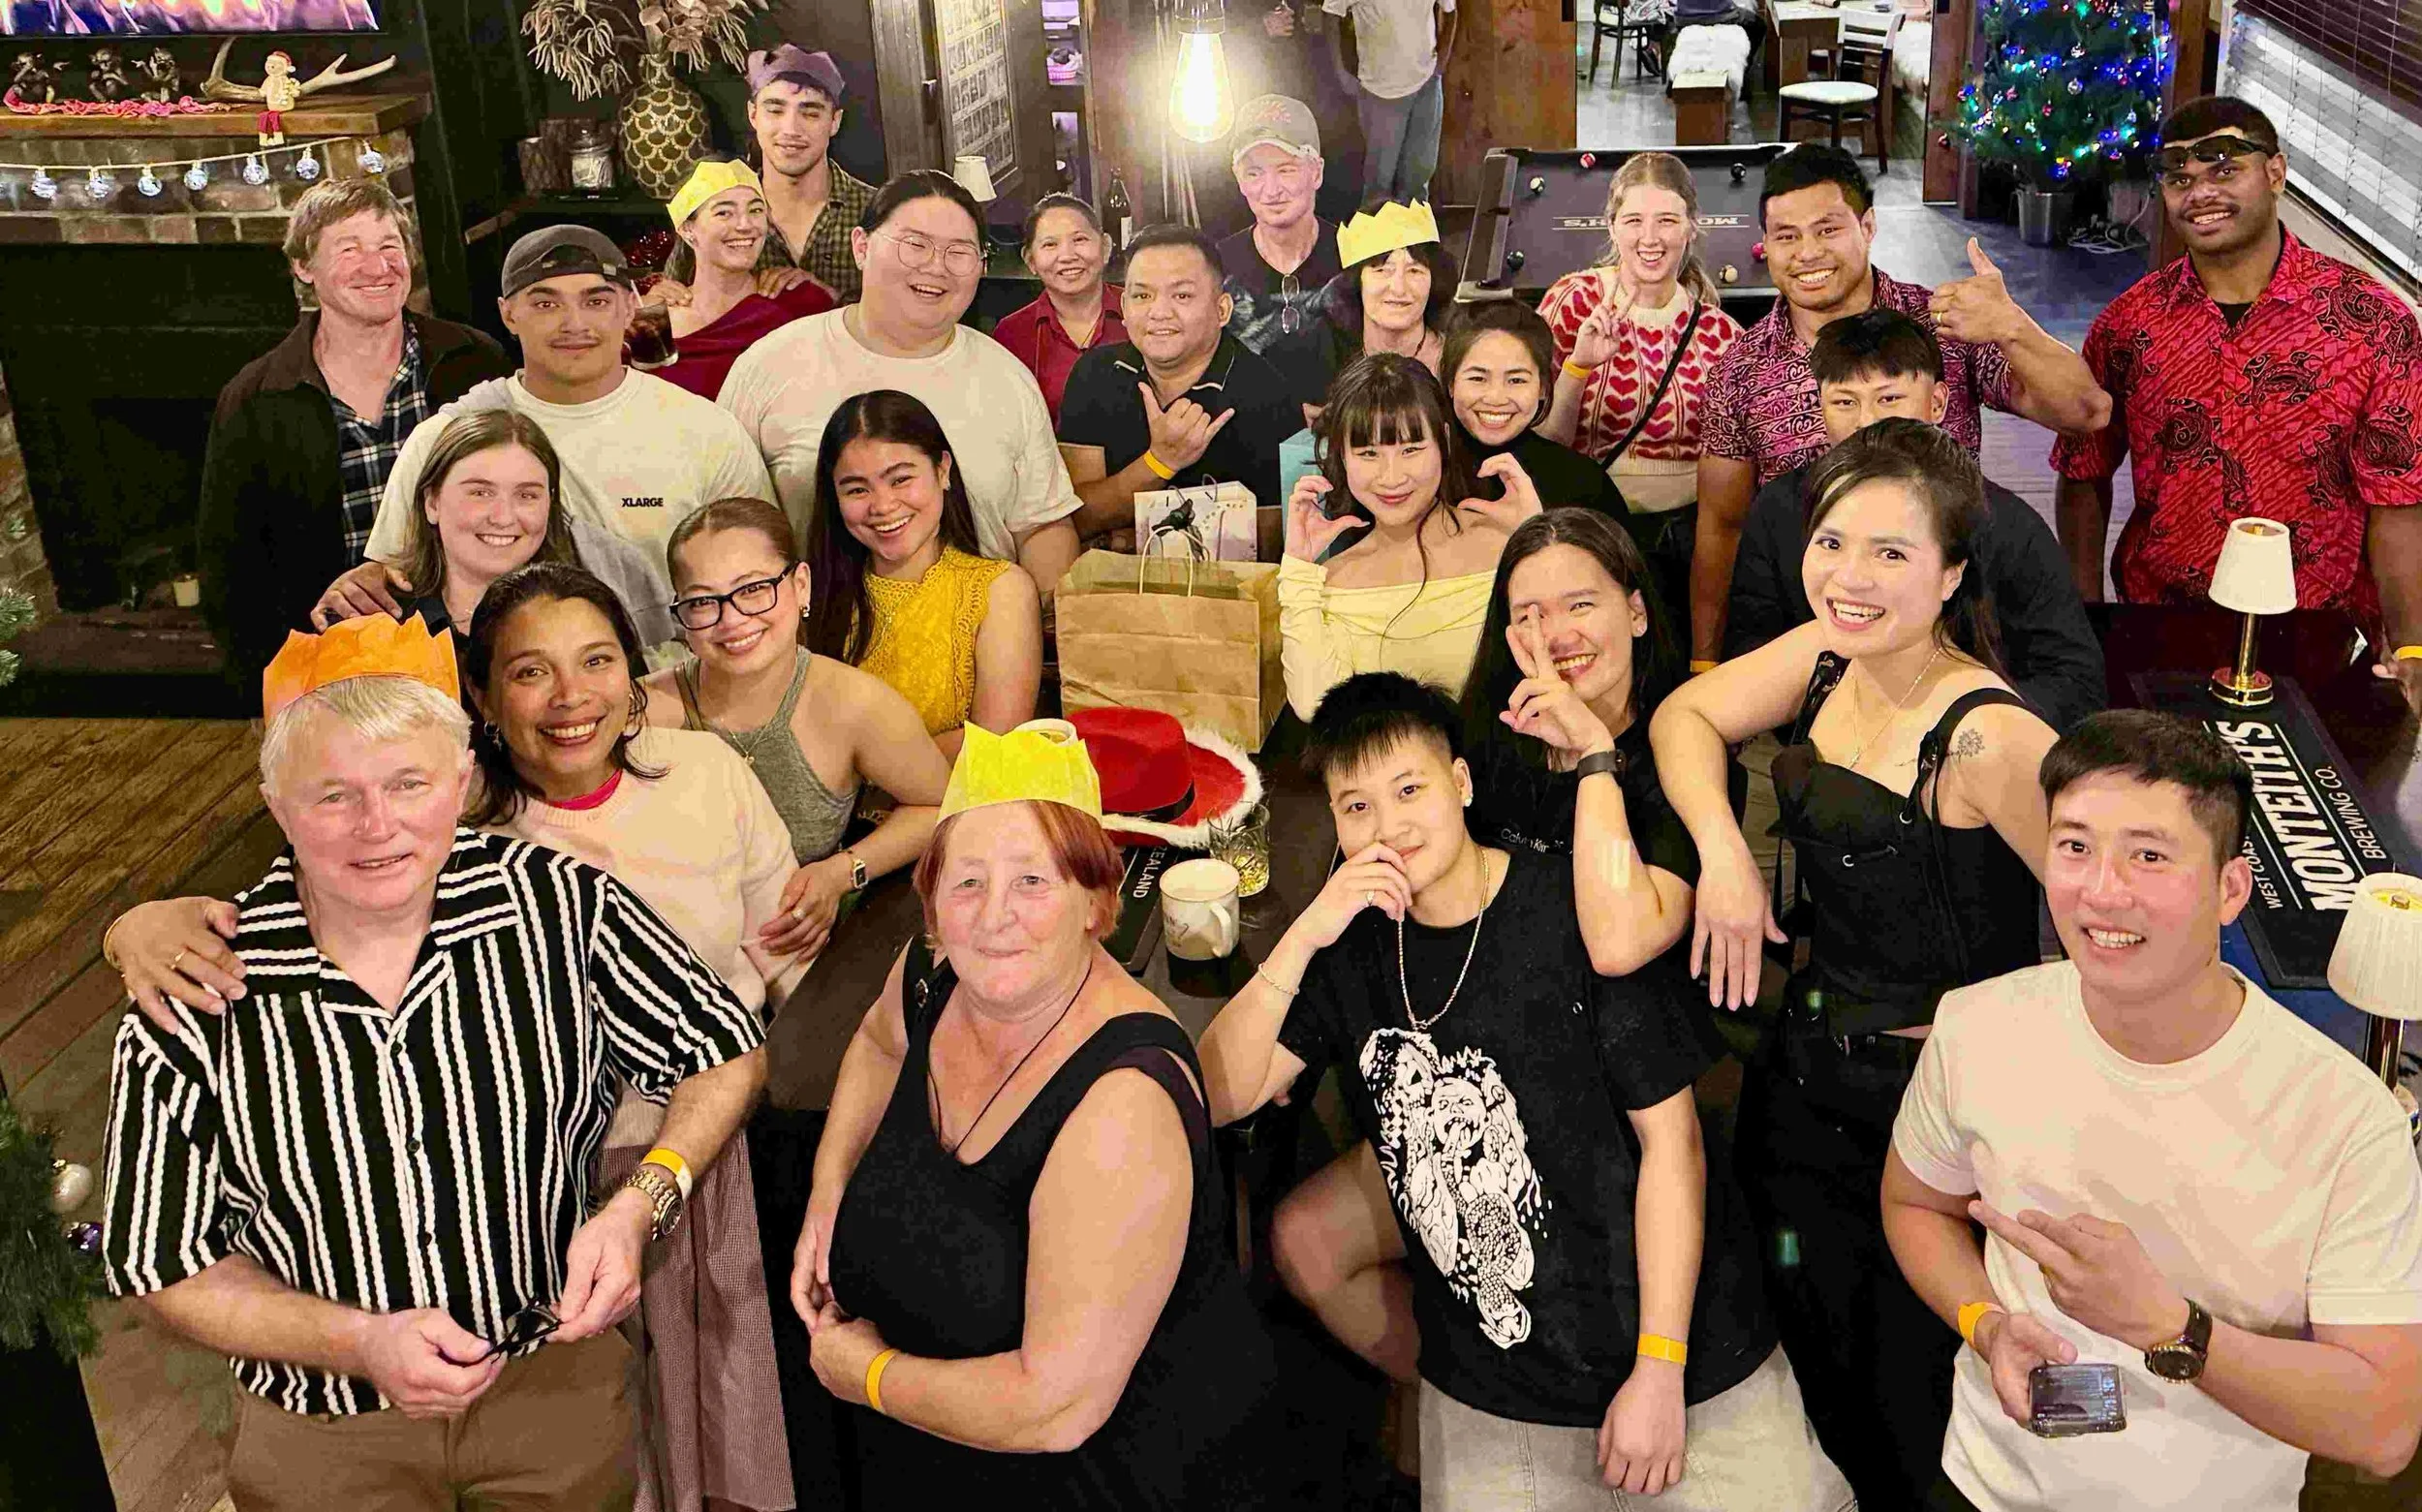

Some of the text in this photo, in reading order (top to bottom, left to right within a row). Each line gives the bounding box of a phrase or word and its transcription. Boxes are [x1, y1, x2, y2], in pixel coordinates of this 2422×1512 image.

[621, 497, 664, 508] XLARGE
[2216, 721, 2360, 910] MONTEITH'S
[2313, 765, 2387, 860] BREWING CO.
[2243, 835, 2283, 910] WEST COAS
